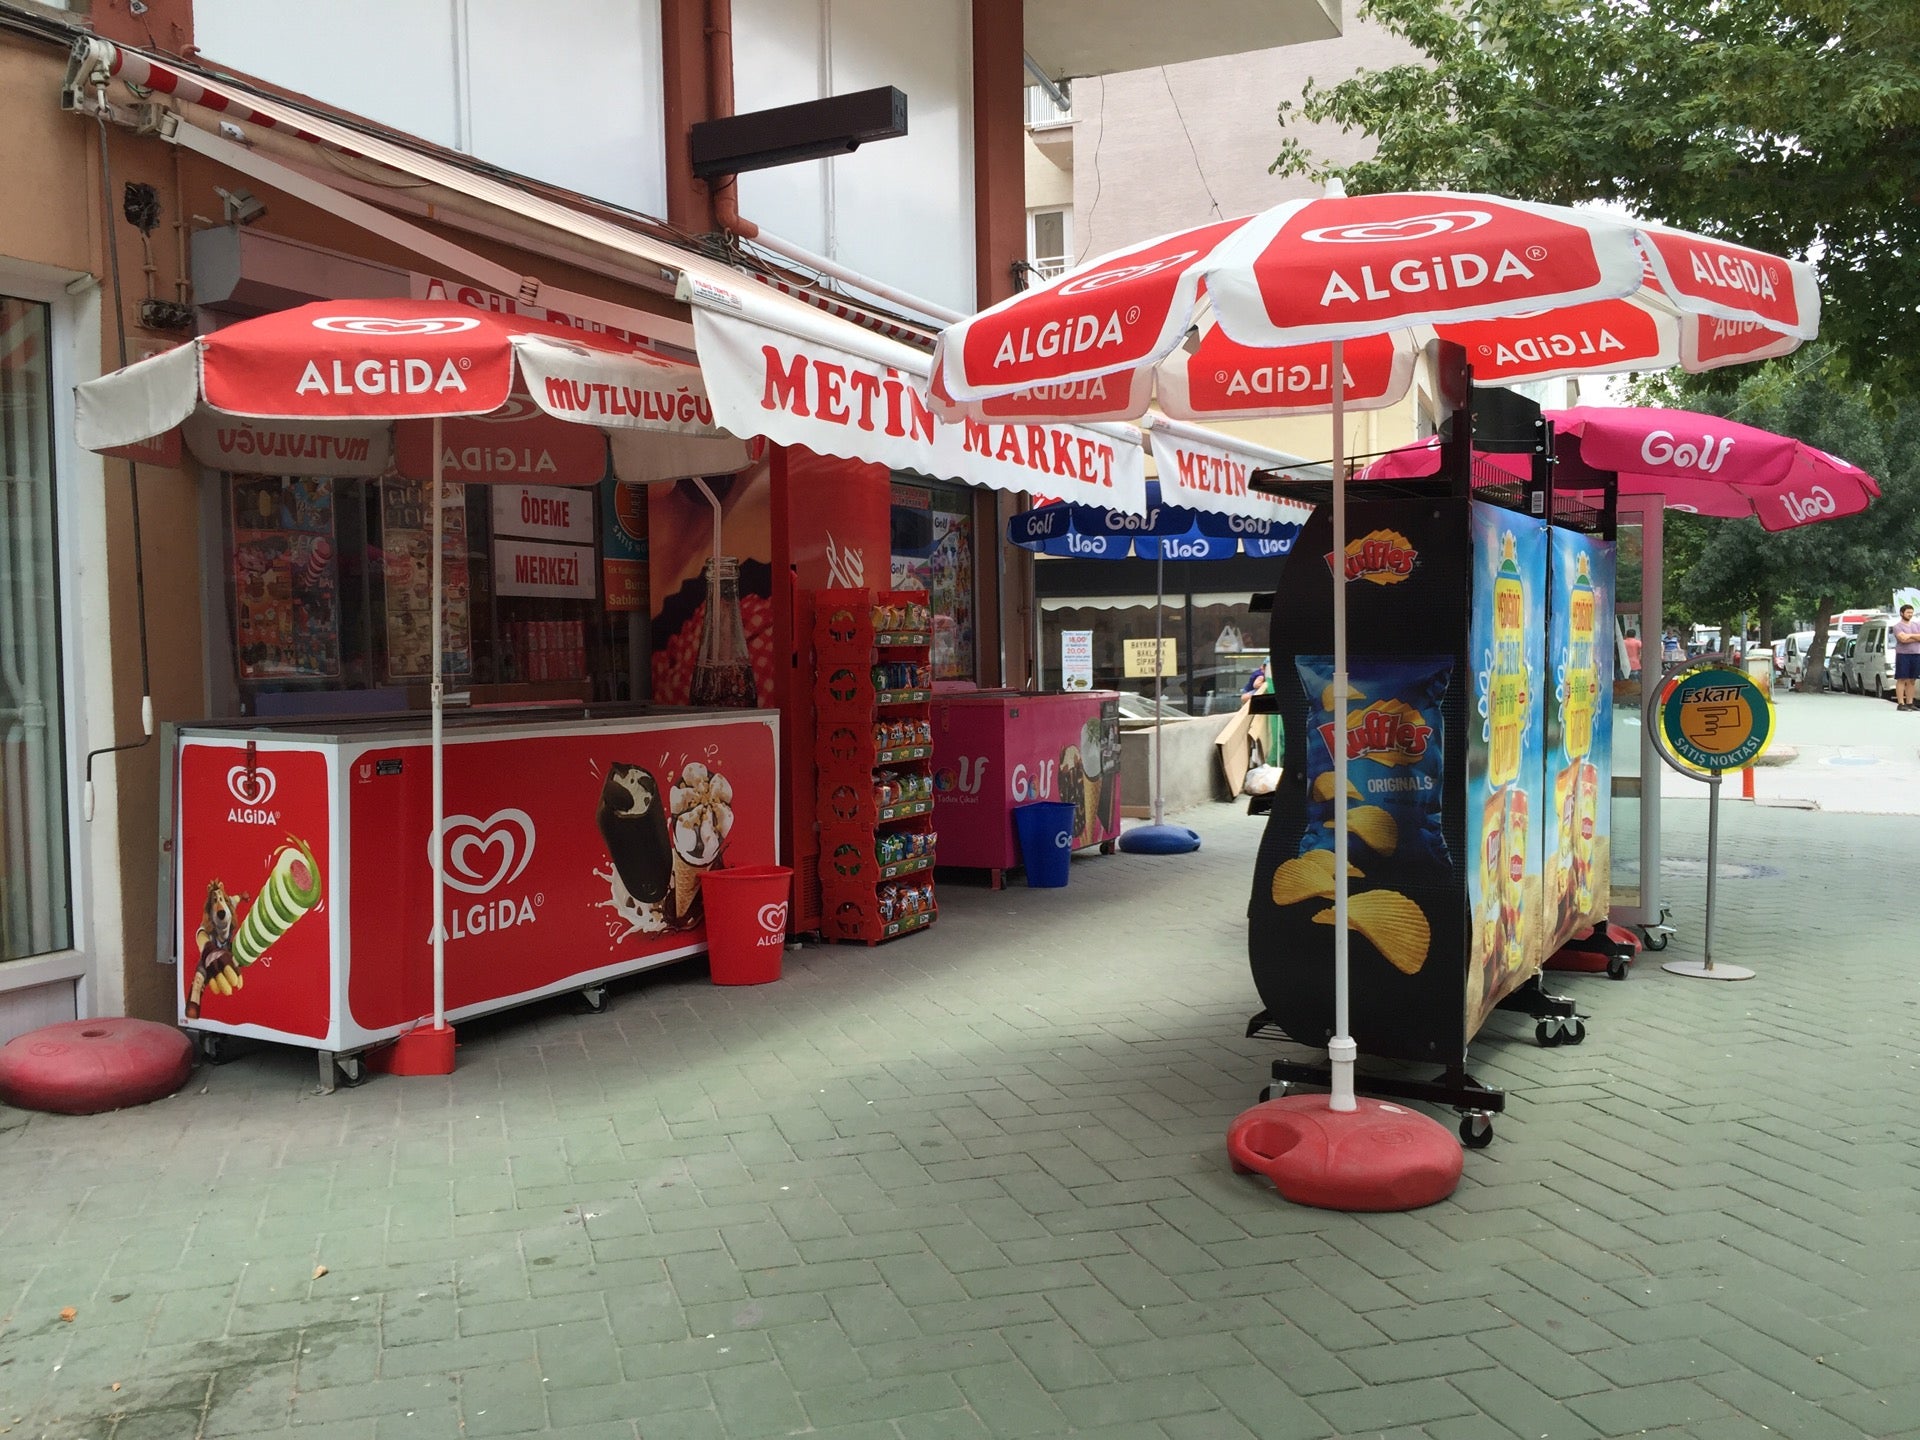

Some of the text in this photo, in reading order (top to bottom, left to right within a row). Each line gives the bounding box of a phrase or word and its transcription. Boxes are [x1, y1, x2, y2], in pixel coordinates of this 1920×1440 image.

[760, 345, 1115, 488] METİN MARKET
[1641, 430, 1736, 473] Golf
[521, 489, 570, 528] ÖDEME
[1027, 512, 1055, 536] Golf
[515, 551, 579, 586] MERKEZİ
[1674, 735, 1761, 766] SATIŞ NOKTASI
[1367, 776, 1433, 793] ORIGINALS
